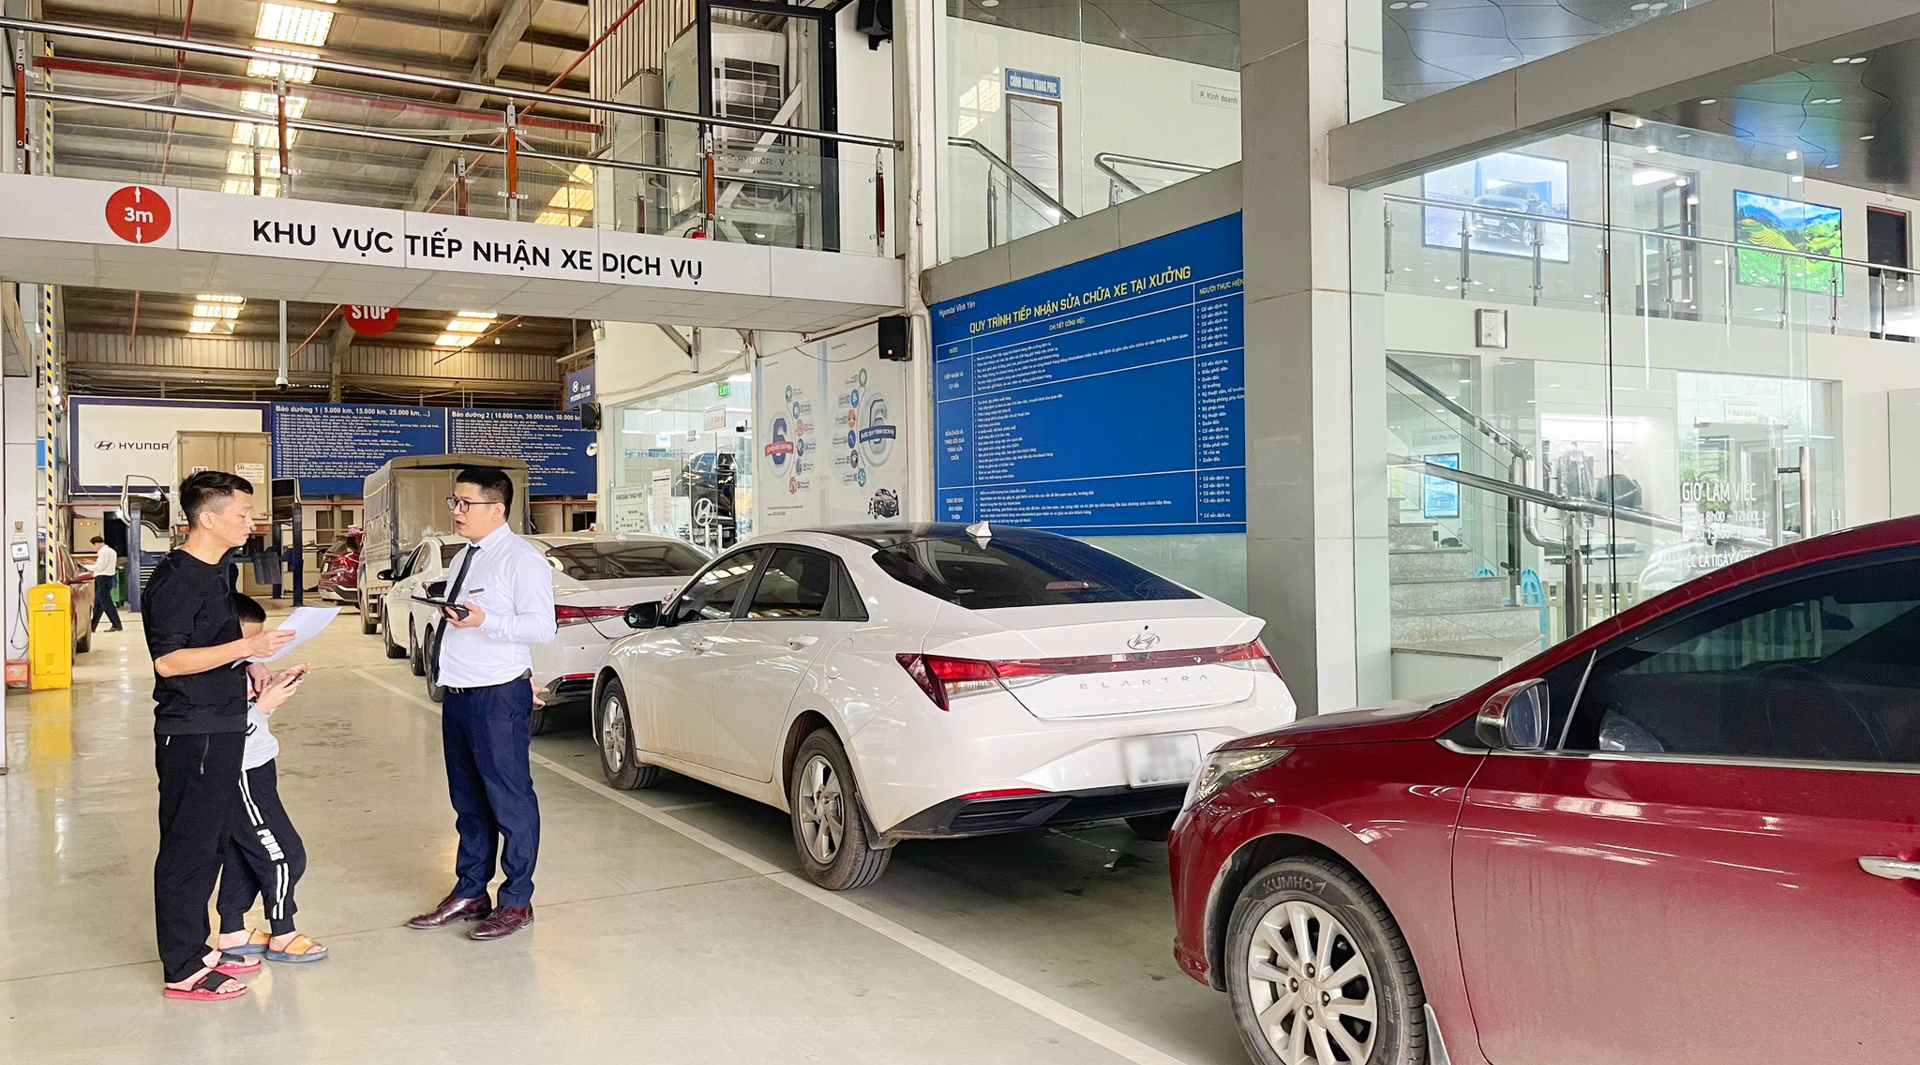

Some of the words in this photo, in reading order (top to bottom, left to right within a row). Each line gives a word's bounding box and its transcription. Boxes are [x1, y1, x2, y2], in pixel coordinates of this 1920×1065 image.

[1207, 92, 1219, 101] Kinh
[1221, 95, 1238, 104] doanh
[124, 206, 153, 223] 3m
[253, 220, 316, 246] KHU
[332, 227, 394, 257] VỰC
[405, 228, 462, 259] TIẾP
[473, 239, 550, 271] NHẬN
[561, 249, 592, 271] XE
[602, 252, 661, 279] DỊCH
[671, 259, 702, 285] VỤ
[969, 319, 986, 334] QUY
[987, 313, 1012, 329] TRÌNH
[1013, 304, 1032, 321] TIẾP
[1034, 301, 1059, 317] NHẬN
[1060, 292, 1081, 311] SỬA
[1083, 286, 1111, 305] CHỮA
[1113, 283, 1128, 298] XE
[1130, 280, 1147, 295] TẠI
[1149, 265, 1191, 288] XƯỞNG
[351, 305, 390, 320] STOP
[938, 306, 956, 318] Hyundai
[956, 303, 966, 312] Vĩnh
[967, 301, 976, 309] Yên
[290, 406, 313, 414] dưỡng
[342, 407, 354, 415] km,
[376, 408, 388, 416] km,
[465, 411, 485, 419] dưỡng
[119, 442, 169, 450] HYUNDA
[1682, 476, 1703, 502] GIỜ
[1733, 480, 1757, 506] VIỆC
[1705, 510, 1726, 522] 8h00
[1698, 550, 1711, 568] CẢ
[1080, 674, 1208, 690] ELANTRA
[1263, 875, 1314, 893] KUMHO
